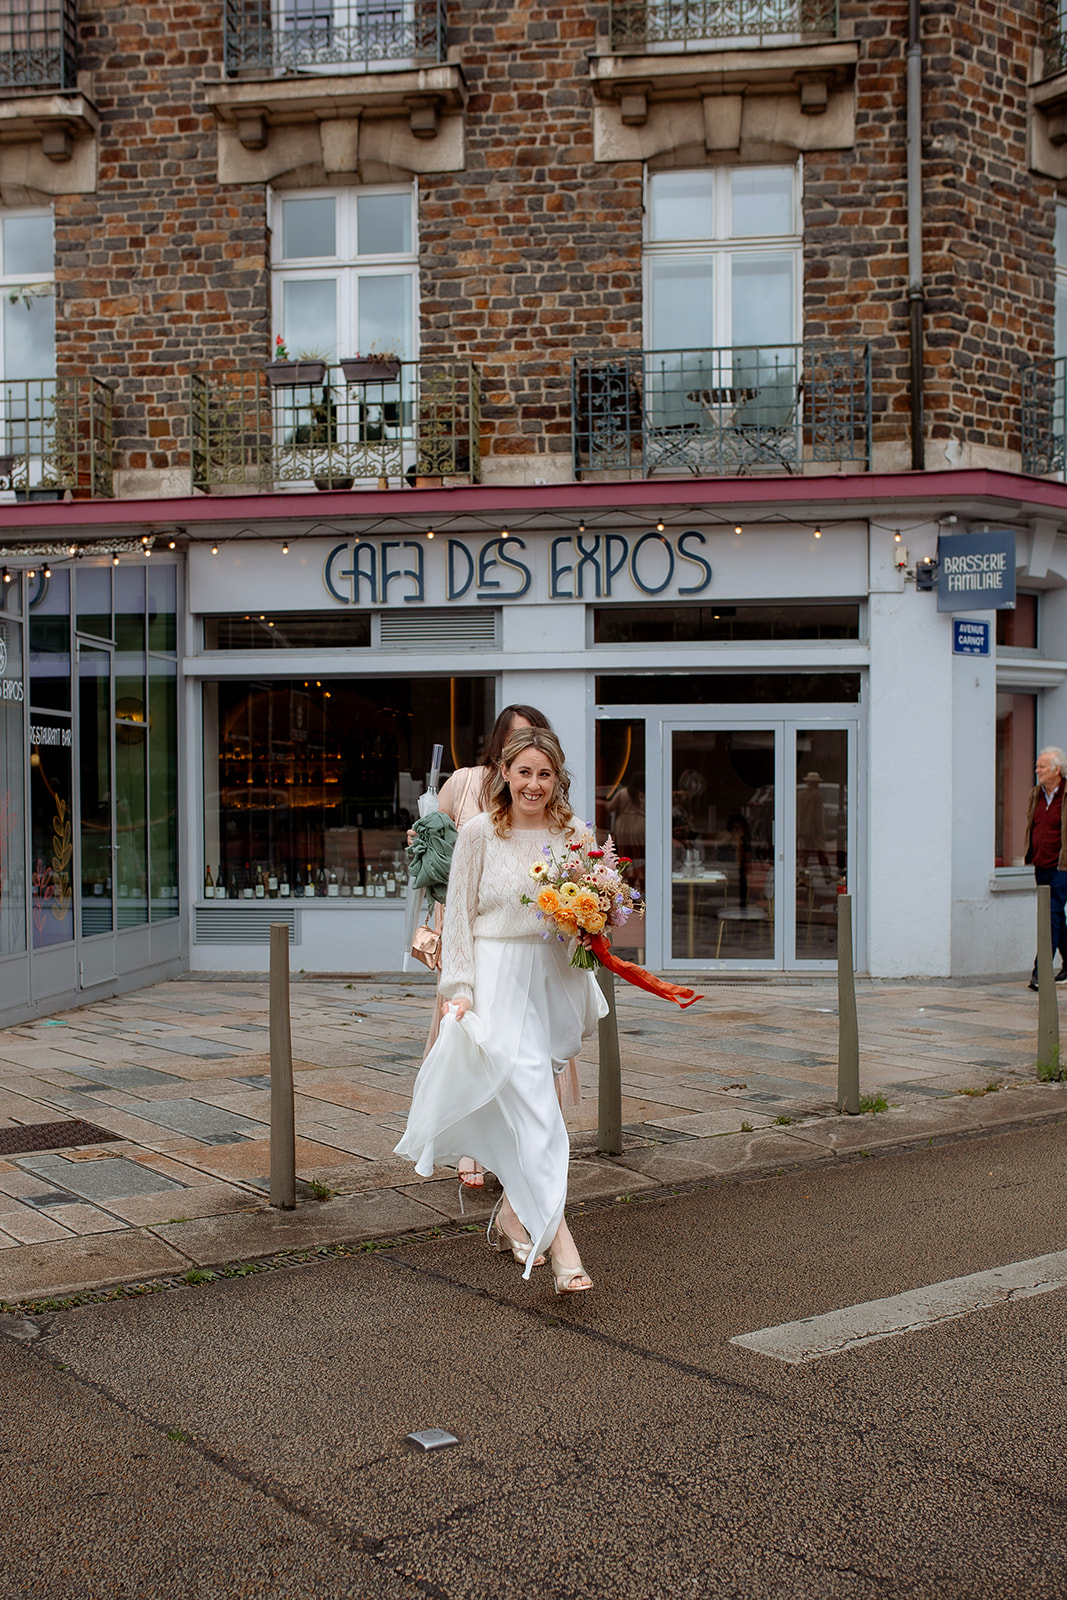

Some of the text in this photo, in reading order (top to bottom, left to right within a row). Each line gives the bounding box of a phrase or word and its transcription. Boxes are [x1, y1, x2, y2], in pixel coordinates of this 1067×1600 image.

[446, 537, 532, 601] DES
[548, 531, 713, 598] EXPOS
[944, 552, 1007, 574] BRASSERIE
[948, 571, 1003, 592] FAMILIALE
[959, 623, 984, 635] AVENUE
[958, 635, 985, 646] CARNOT
[3, 679, 24, 702] EXPOS
[29, 726, 72, 747] RESTAURANT BAR
